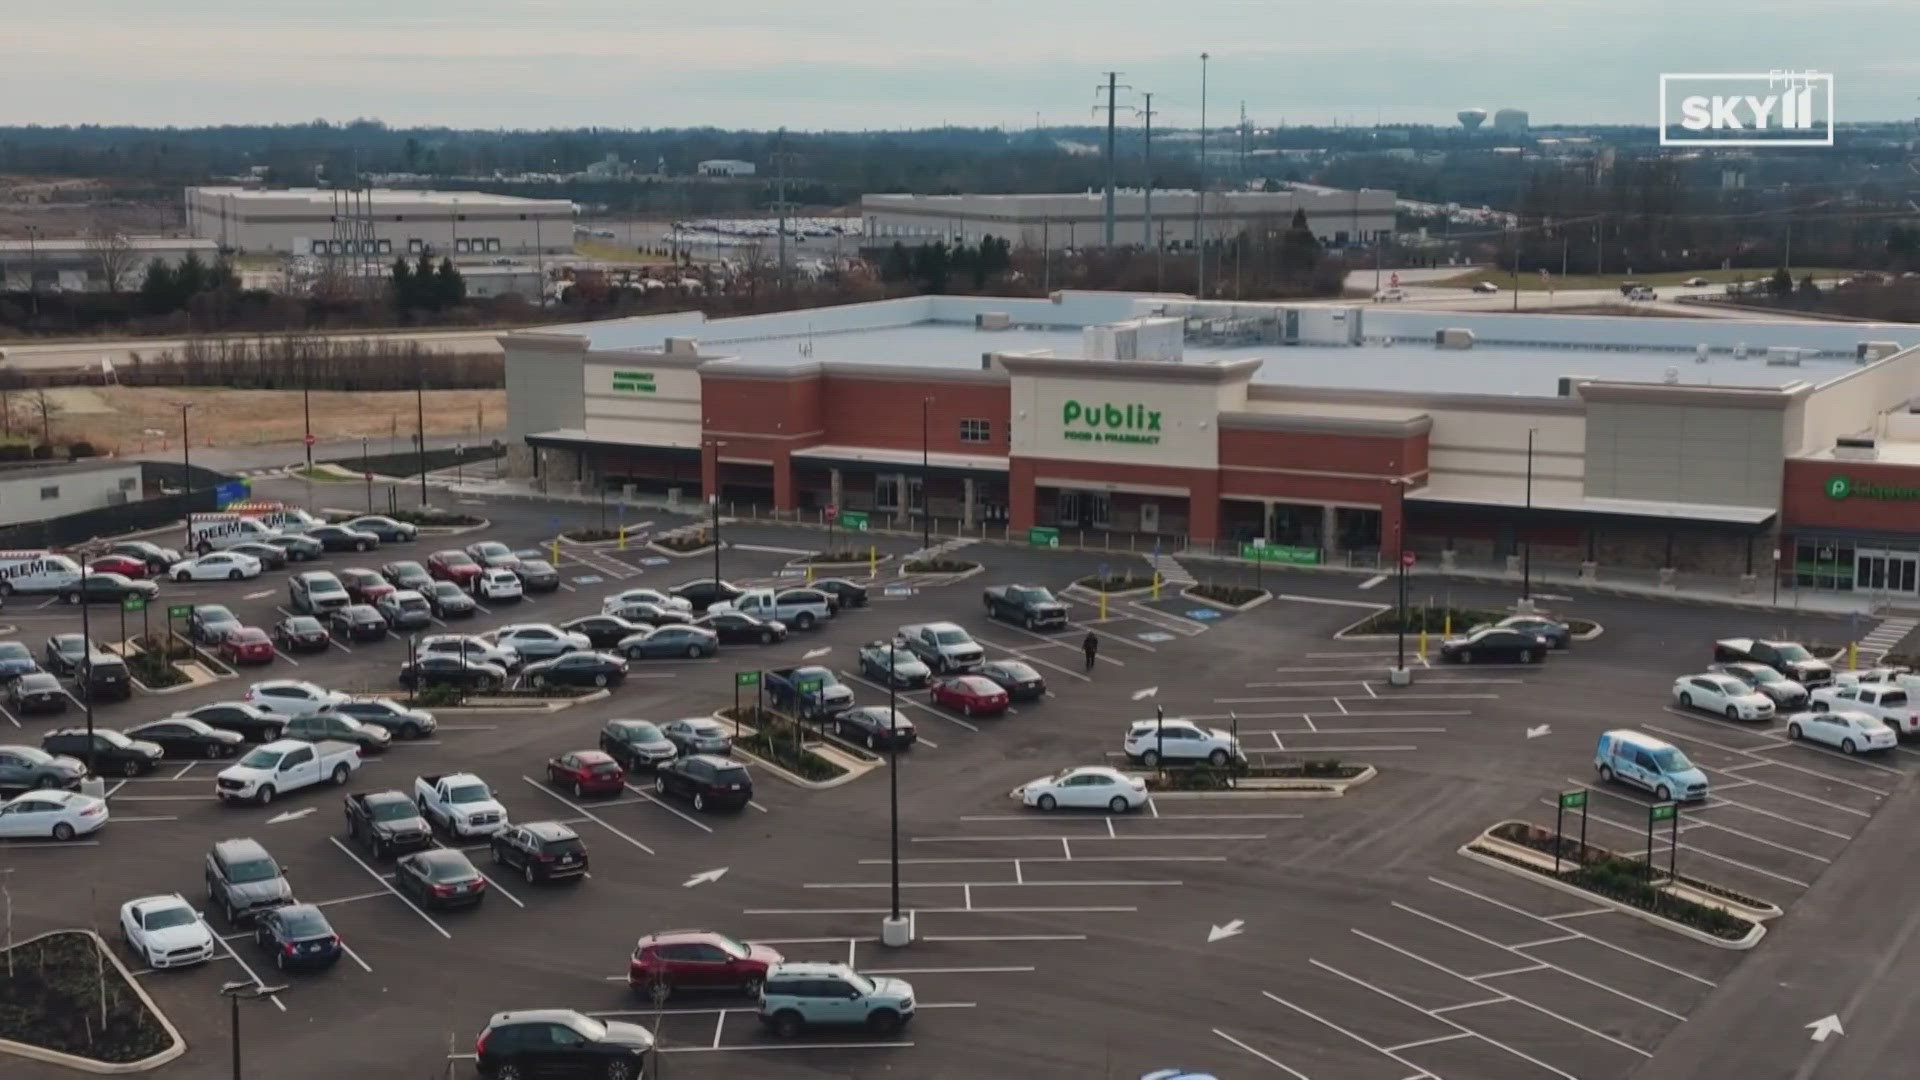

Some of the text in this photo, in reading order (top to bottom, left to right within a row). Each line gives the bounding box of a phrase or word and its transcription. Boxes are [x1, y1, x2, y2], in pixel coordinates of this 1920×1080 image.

[1064, 400, 1161, 430] Publix
[1064, 431, 1160, 445] FOOD & PHARMACY
